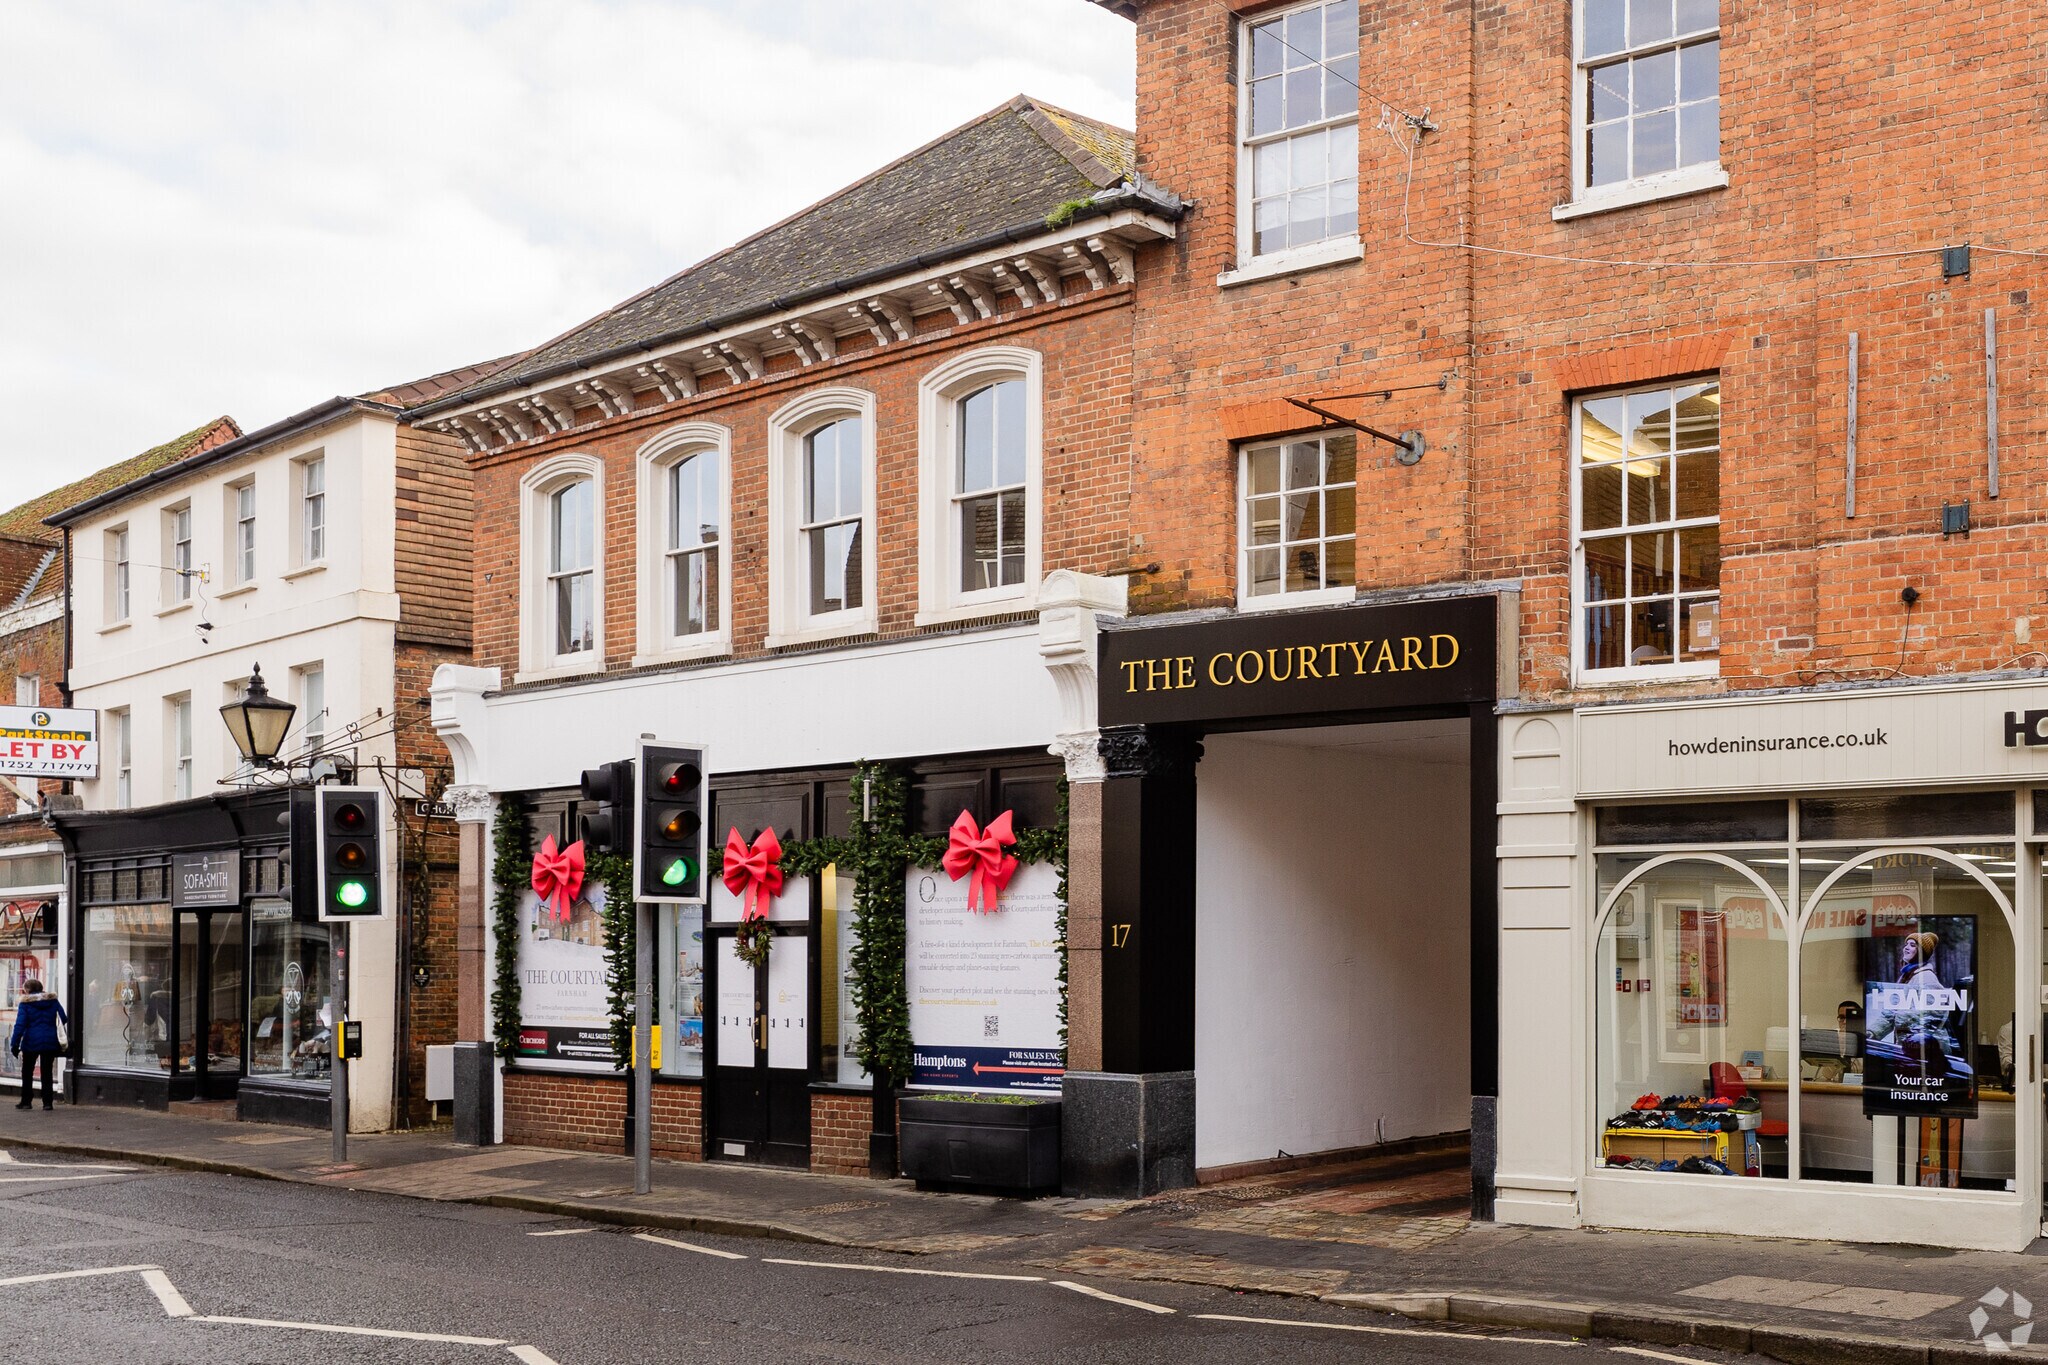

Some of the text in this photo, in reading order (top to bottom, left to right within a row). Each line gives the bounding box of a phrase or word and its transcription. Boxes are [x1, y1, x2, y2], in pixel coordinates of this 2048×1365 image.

[1120, 634, 1460, 693] THE COURTYARD
[0, 728, 86, 741] ParkSteele
[1668, 728, 1888, 756] howdeninsurance.co.uk
[52, 744, 86, 760] BY
[42, 762, 92, 770] 717979
[1011, 904, 1039, 914] Courtyard
[1112, 924, 1131, 948] 17
[961, 940, 993, 949] development
[525, 970, 548, 984] THE
[954, 986, 971, 995] perfect
[1014, 987, 1036, 996] stunning
[1872, 988, 1968, 1012] HOWDEN
[913, 1053, 967, 1070] Hamptons
[1894, 1074, 1944, 1086] Your car
[1890, 1089, 1948, 1101] insurance
